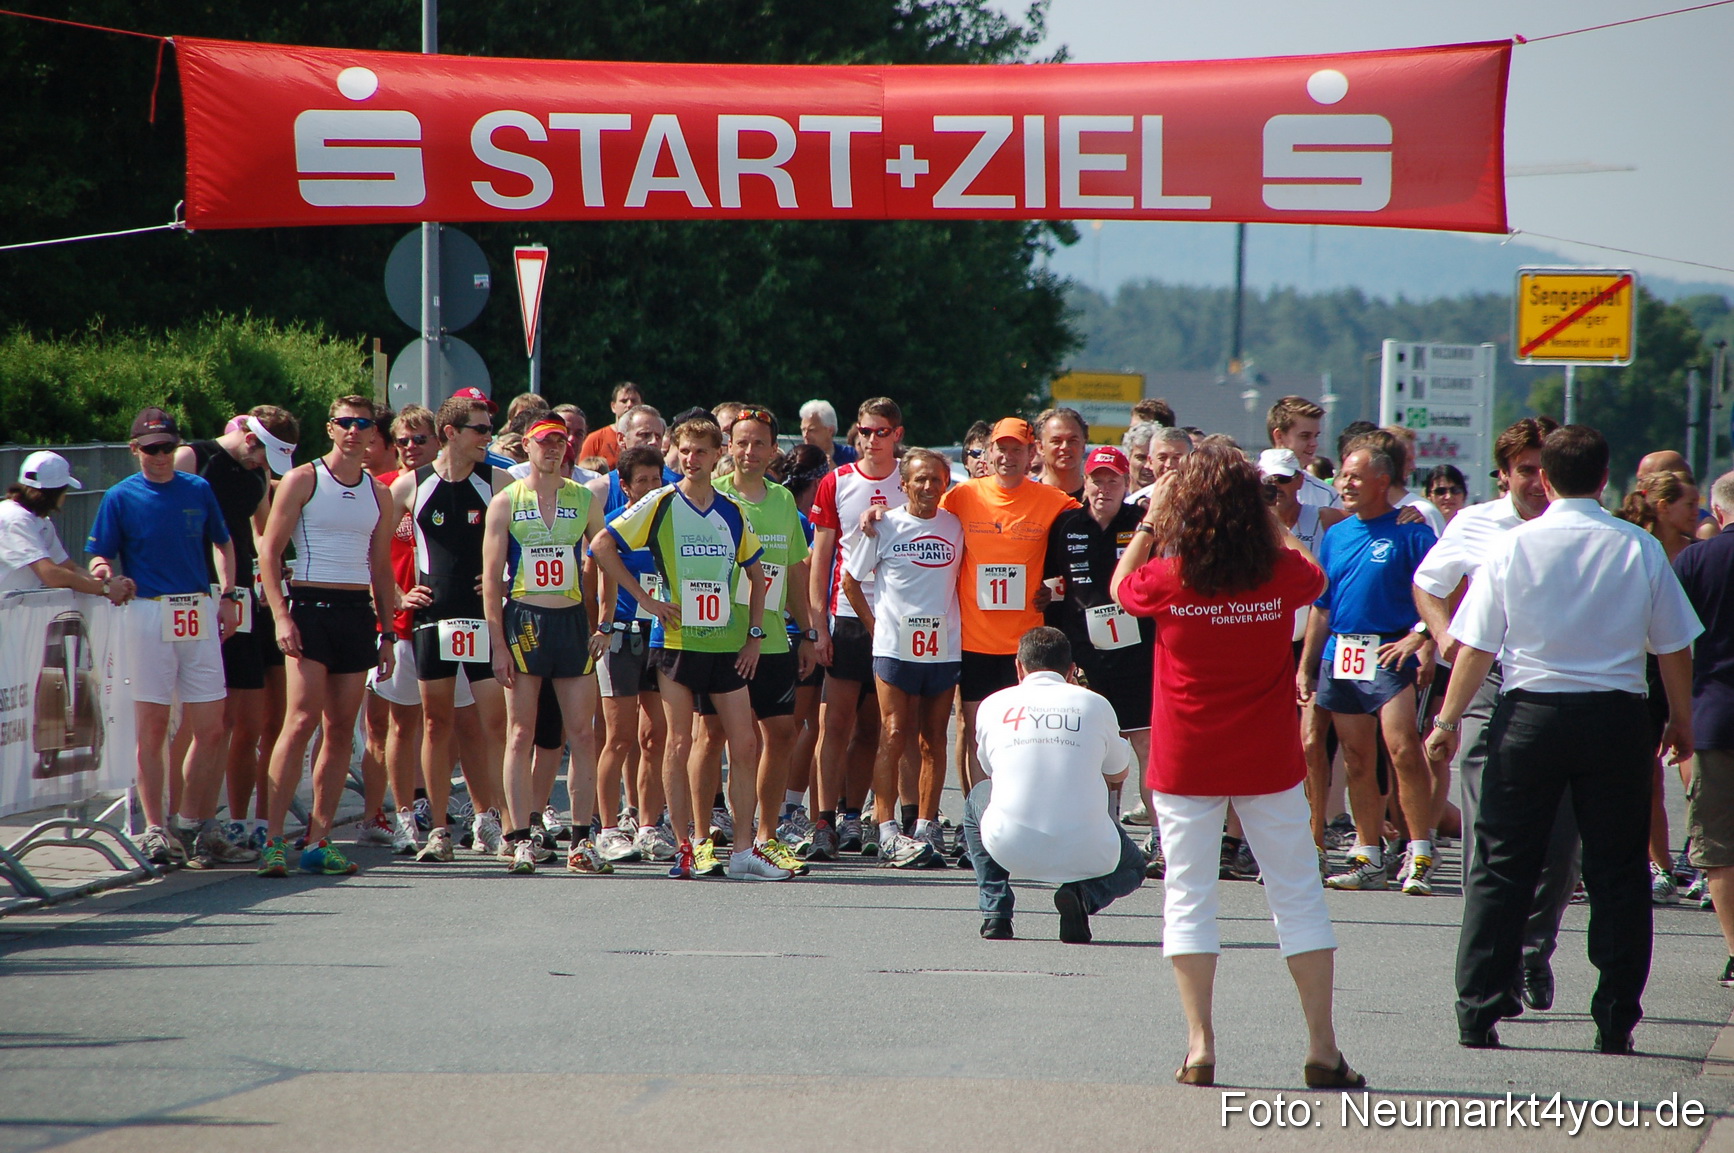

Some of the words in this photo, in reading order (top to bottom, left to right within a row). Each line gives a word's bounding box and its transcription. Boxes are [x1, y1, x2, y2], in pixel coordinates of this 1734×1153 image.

[513, 506, 578, 521] BOCK
[681, 534, 713, 543] TEAM
[758, 534, 787, 542] NDHEIT
[893, 543, 945, 552] GERHART
[681, 544, 727, 557] BOCK
[535, 559, 564, 587] 99
[990, 578, 1007, 605] 11
[696, 594, 720, 621] 10
[1094, 606, 1117, 615] MEYER
[1170, 604, 1223, 616] ReCover
[1228, 597, 1281, 613] Yourself
[173, 609, 199, 637] 56
[1107, 617, 1119, 643] 1
[1211, 615, 1253, 625] FOREVER
[452, 630, 475, 657] 81
[912, 630, 939, 657] 64
[1342, 647, 1366, 674] 85
[1002, 706, 1026, 731] 4
[1027, 706, 1081, 715] Neumarkt
[1029, 713, 1081, 732] YOU
